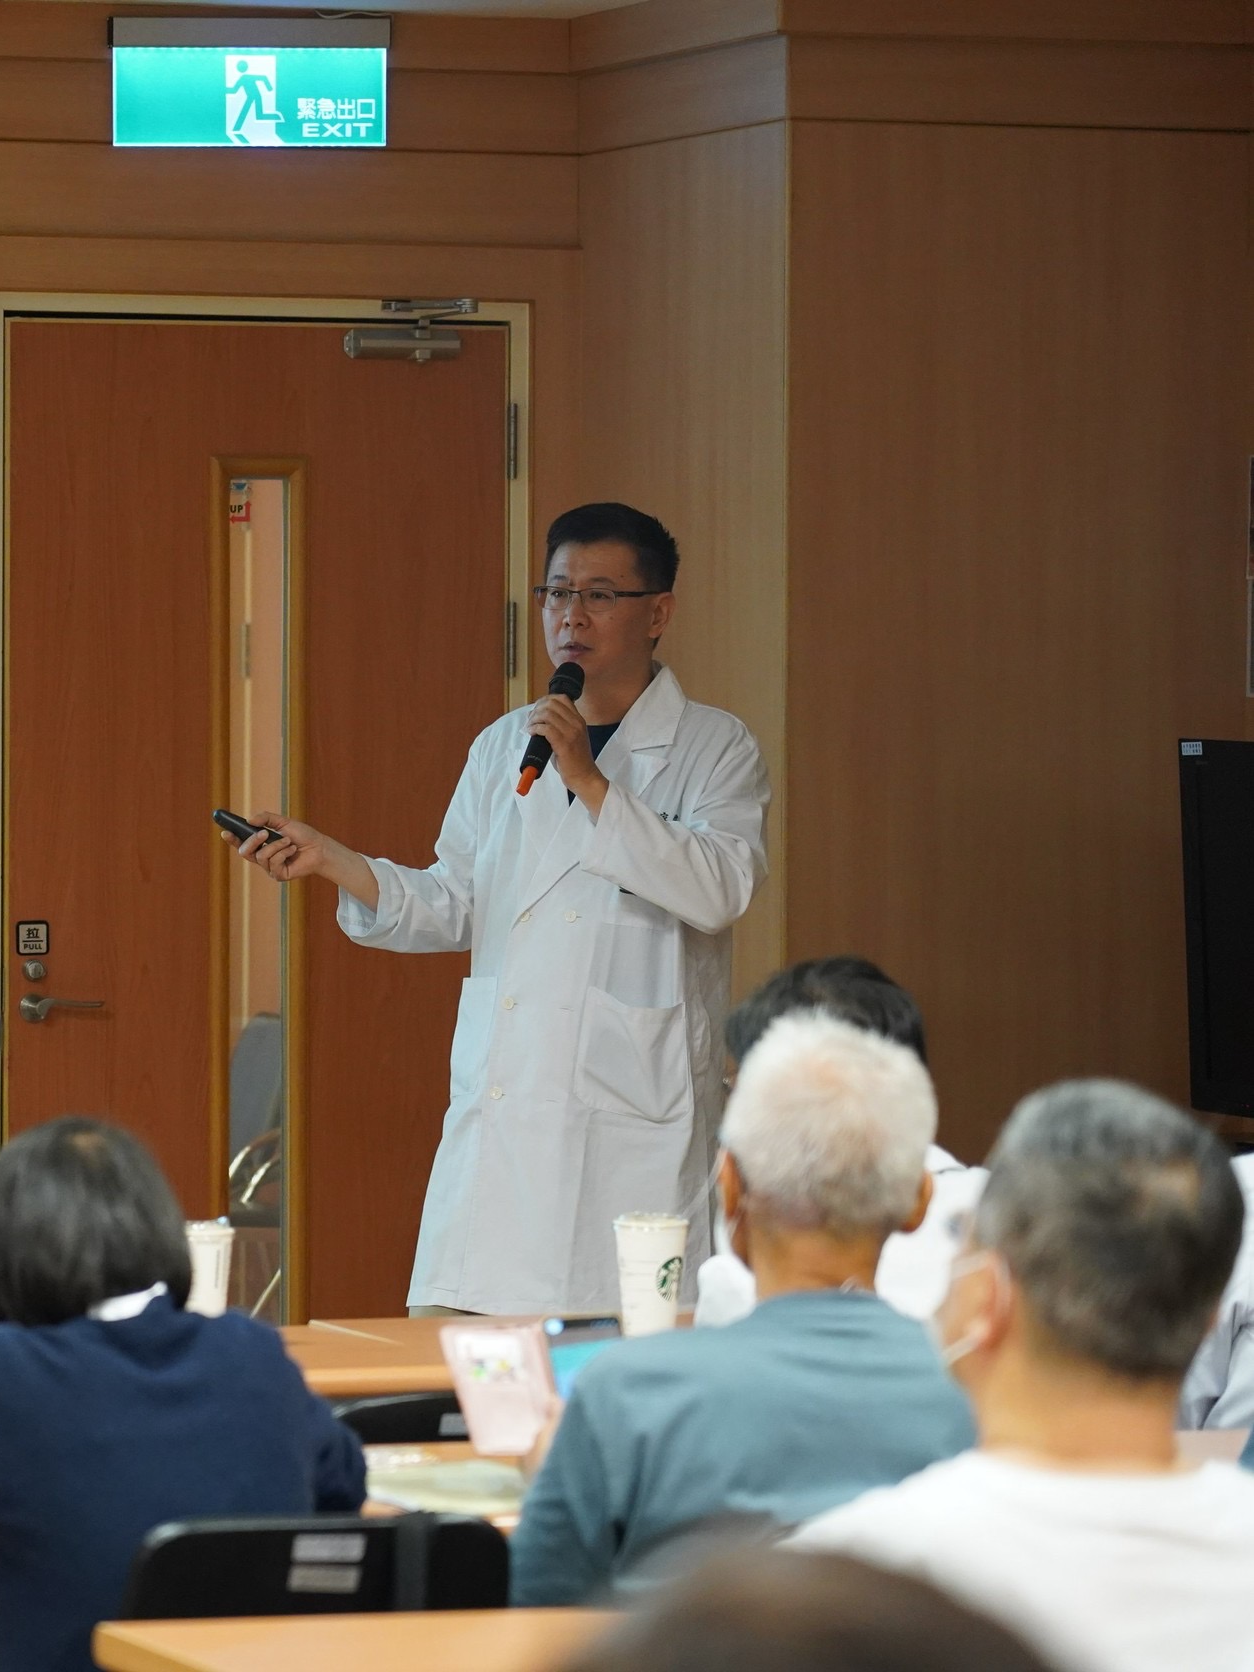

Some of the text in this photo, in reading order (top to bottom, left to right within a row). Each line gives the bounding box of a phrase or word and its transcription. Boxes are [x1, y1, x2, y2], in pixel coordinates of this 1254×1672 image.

[297, 98, 375, 119] 緊急出口
[302, 123, 373, 137] EXIT
[26, 928, 40, 938] 拉
